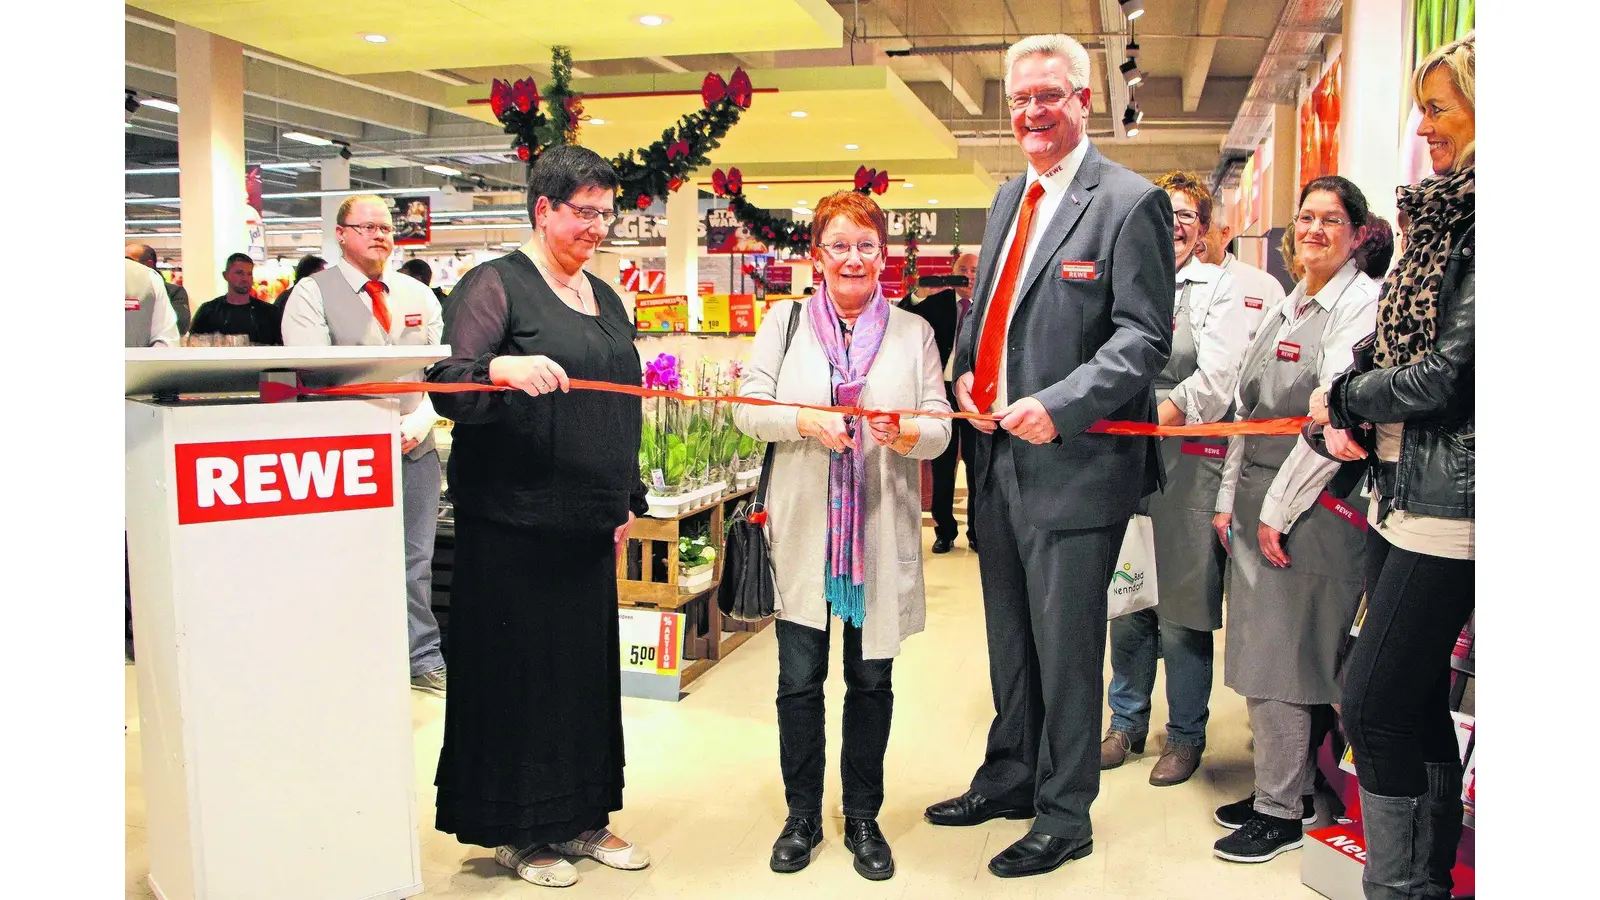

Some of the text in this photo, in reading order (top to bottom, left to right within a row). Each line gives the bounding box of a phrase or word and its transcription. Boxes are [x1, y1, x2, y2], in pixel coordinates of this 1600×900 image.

[1044, 165, 1063, 178] REWE
[1068, 271, 1089, 279] REWE
[1281, 350, 1294, 359] REWE
[1204, 447, 1220, 455] REWE
[196, 448, 378, 508] REWE
[1335, 504, 1353, 519] REWE
[1134, 571, 1144, 582] Bad
[630, 645, 655, 666] 5.00
